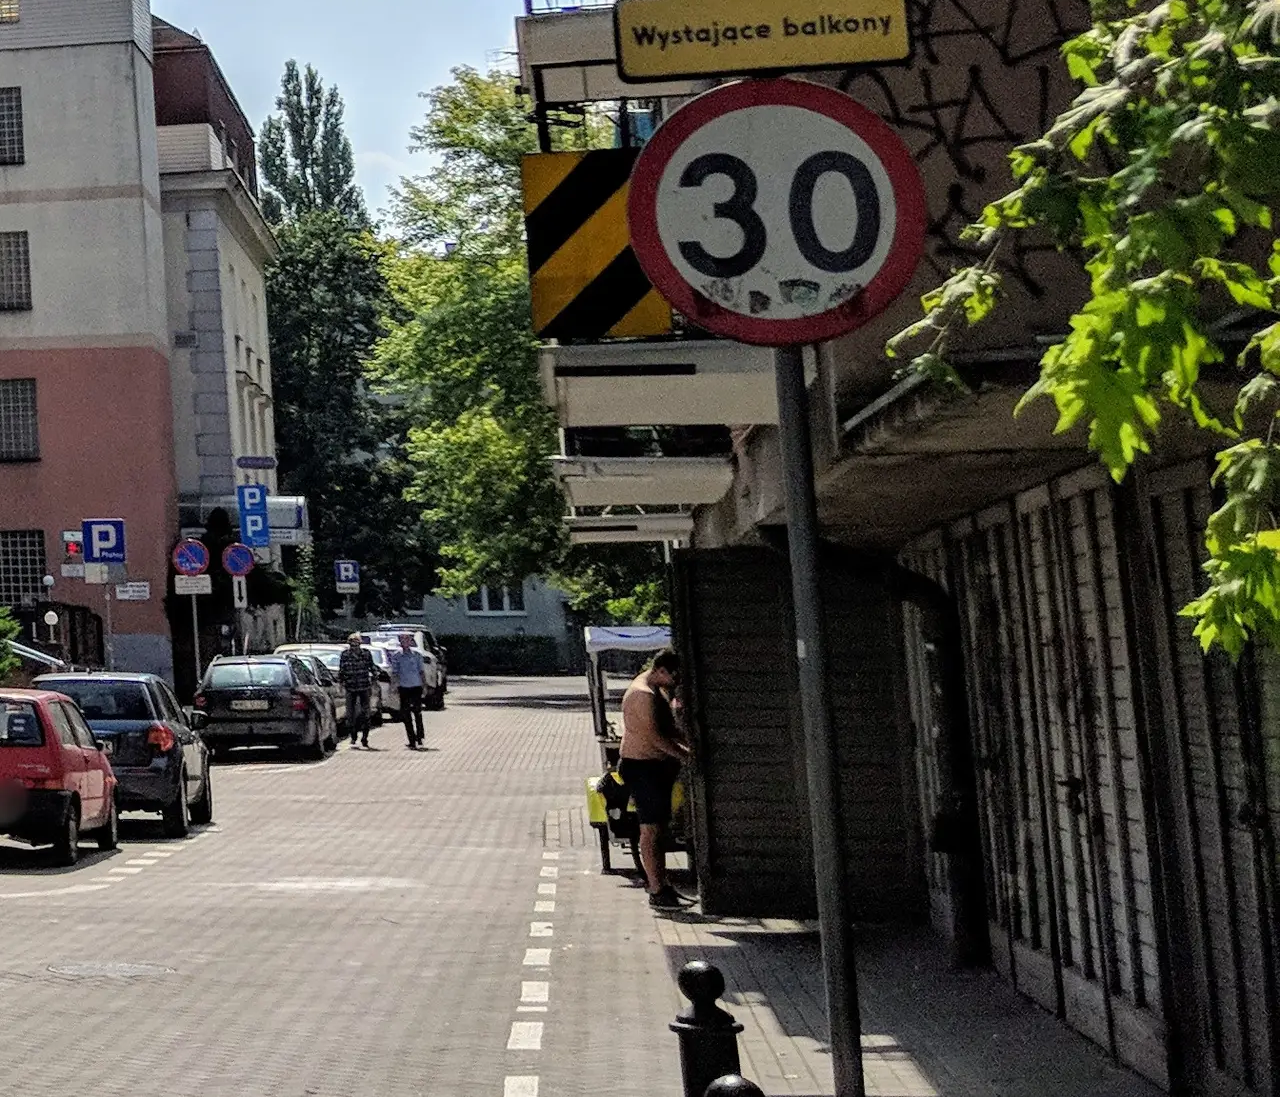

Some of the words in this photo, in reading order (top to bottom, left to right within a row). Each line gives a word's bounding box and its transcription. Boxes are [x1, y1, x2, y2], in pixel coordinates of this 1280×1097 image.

[632, 21, 772, 51] Wystające
[782, 15, 891, 36] balkony
[677, 151, 881, 279] 30
[244, 488, 260, 510] P
[92, 524, 116, 558] P
[246, 515, 263, 537] P
